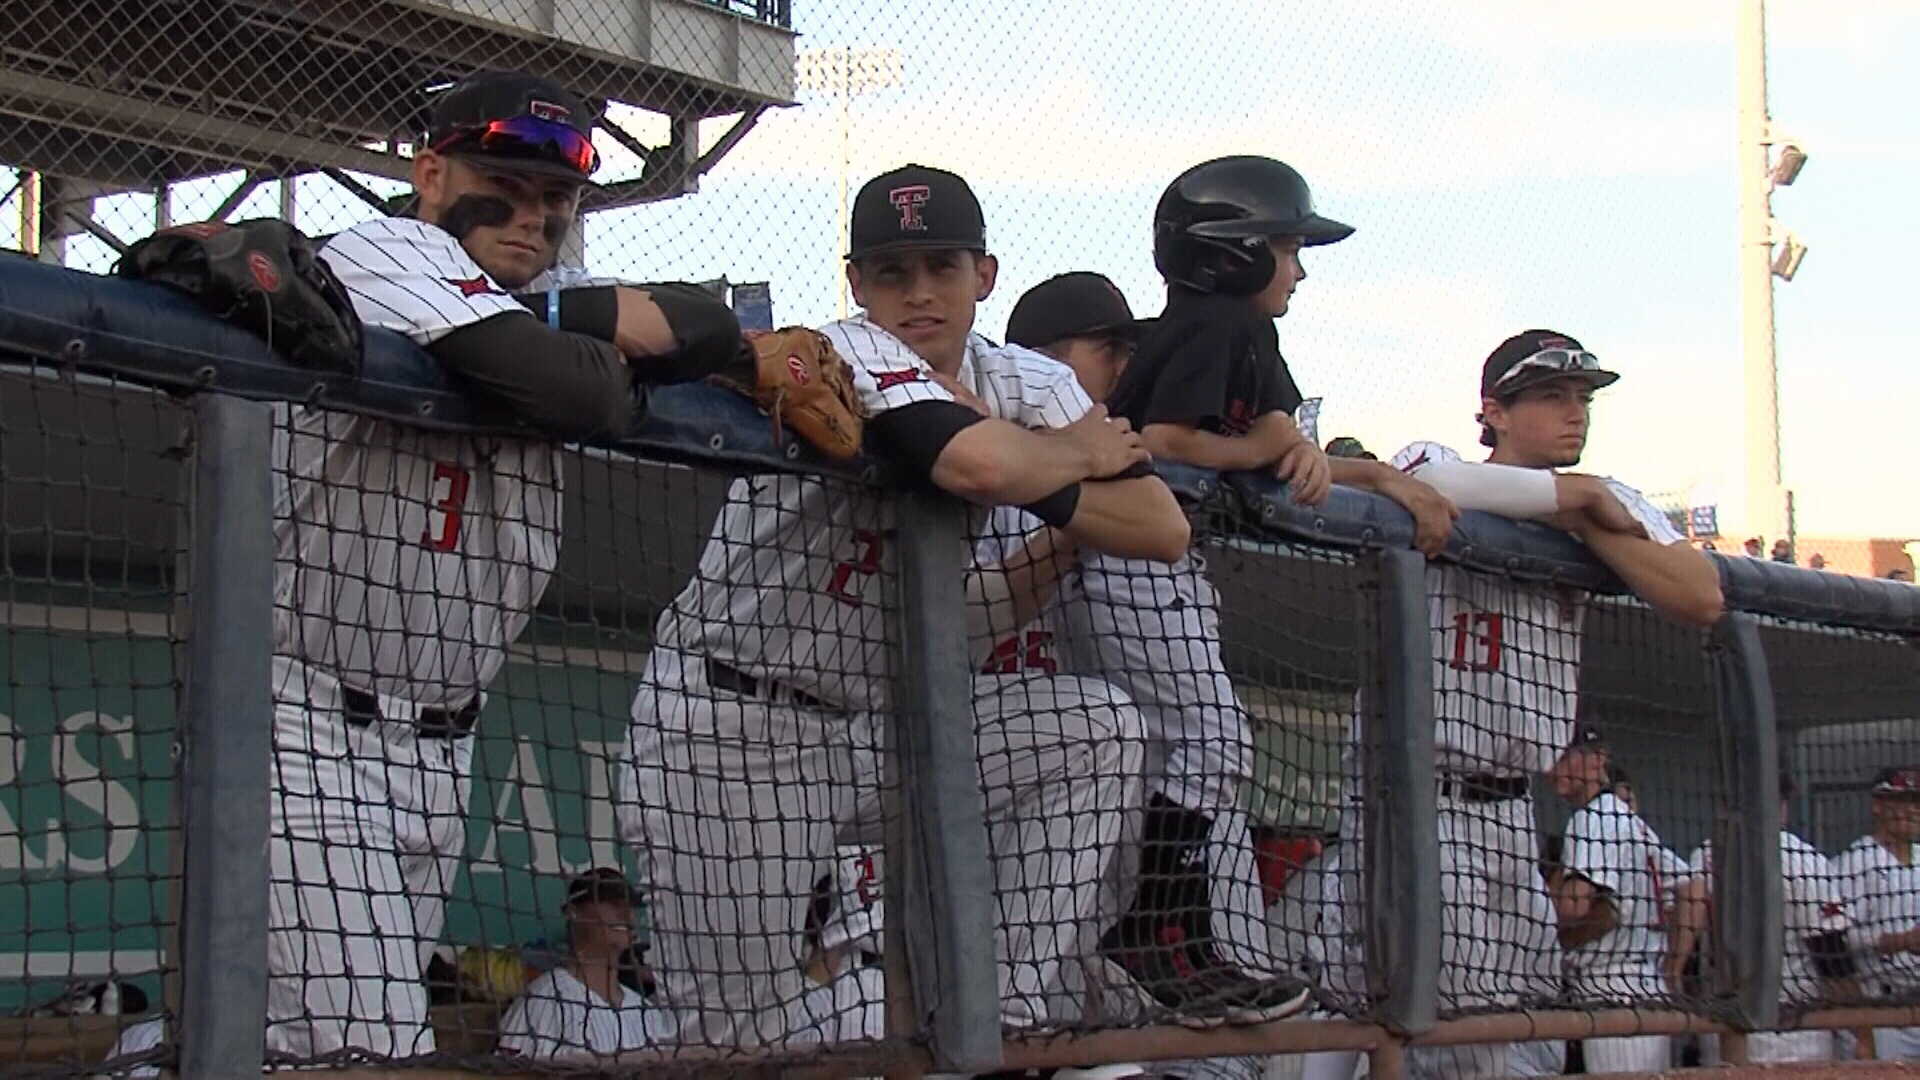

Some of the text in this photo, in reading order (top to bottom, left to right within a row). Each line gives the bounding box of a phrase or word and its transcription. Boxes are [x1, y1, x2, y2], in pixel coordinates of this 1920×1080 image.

[421, 462, 470, 552] 3
[826, 529, 883, 608] 2
[1449, 612, 1504, 672] 13
